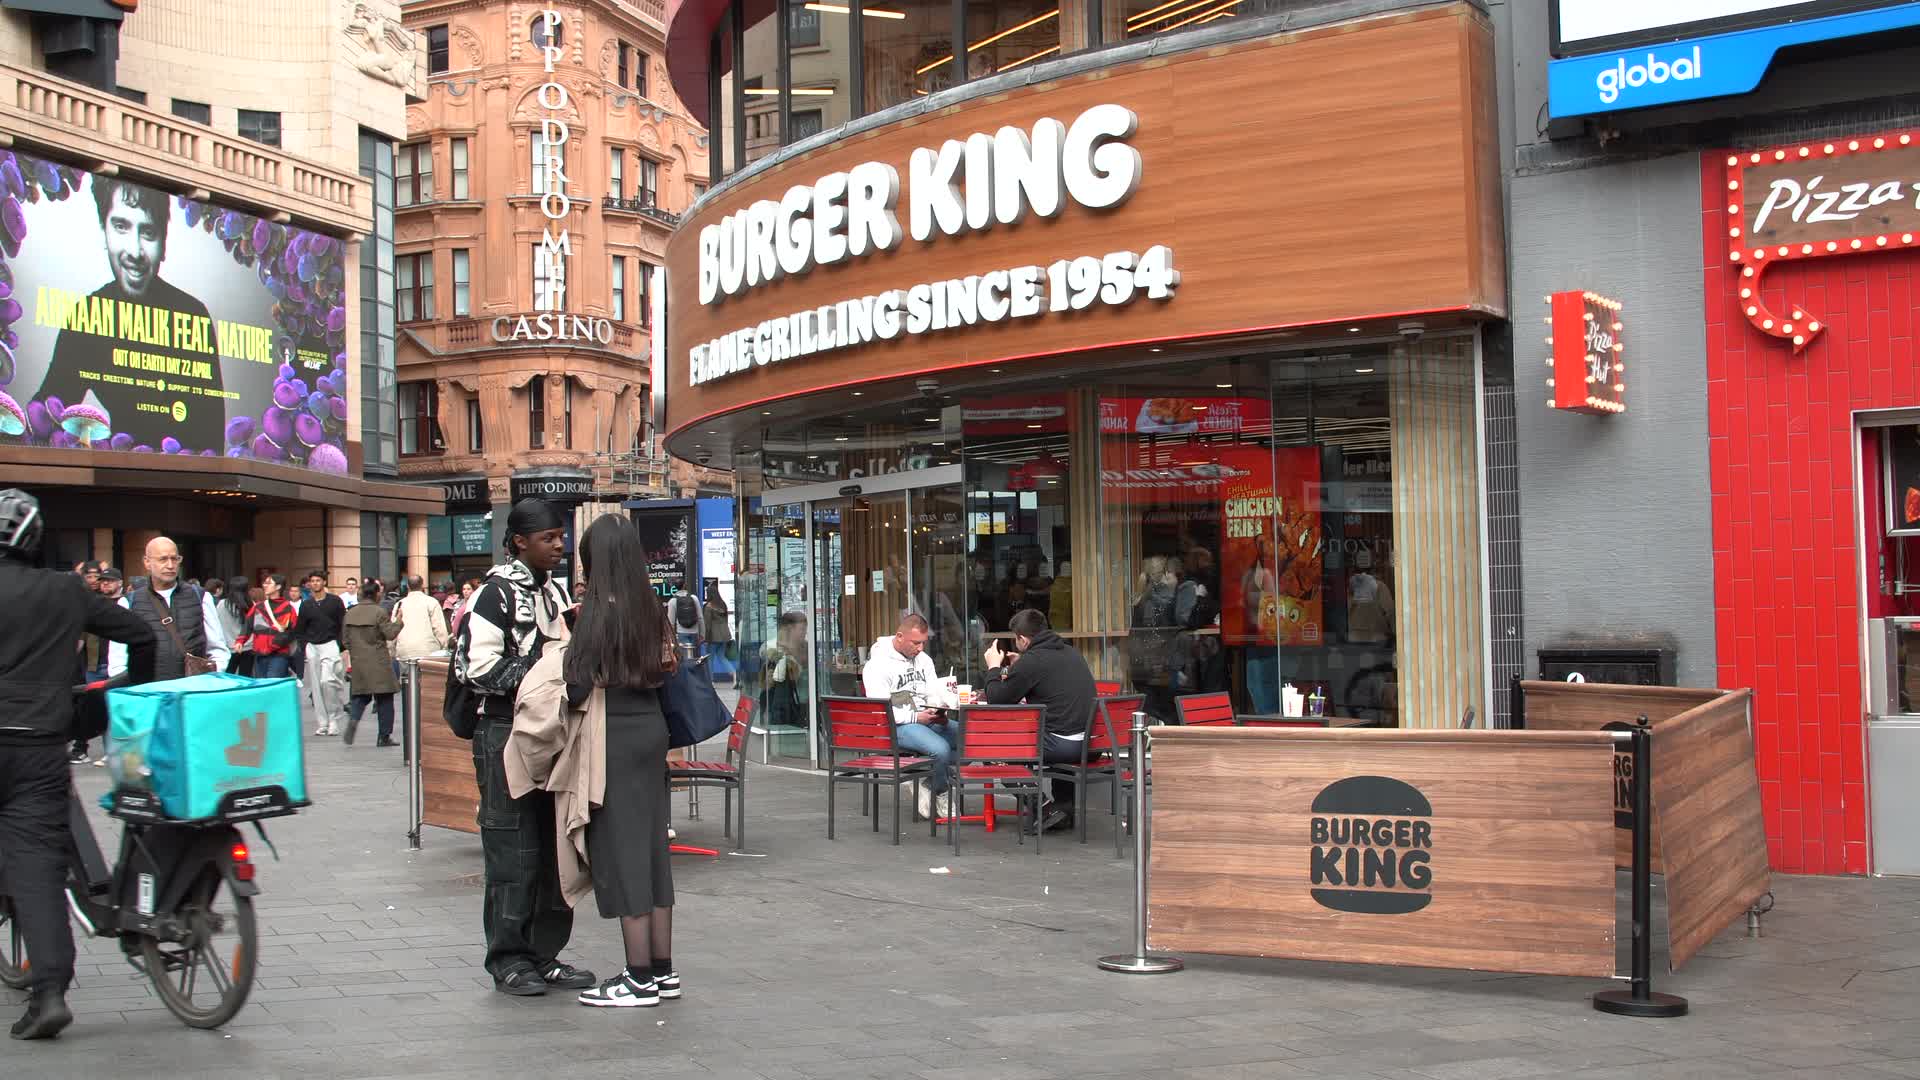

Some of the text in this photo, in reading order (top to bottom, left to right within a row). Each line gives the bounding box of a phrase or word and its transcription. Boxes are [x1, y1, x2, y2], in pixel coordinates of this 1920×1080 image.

[1595, 45, 1701, 103] global
[698, 103, 1142, 305] BURGER KING
[1752, 175, 1905, 233] Pizza
[34, 286, 273, 365] ARMAAN MALIK FEAT. NATURE
[490, 313, 614, 345] CASINO
[689, 244, 1181, 387] FLAME GRILLING SINCE 1954
[1586, 320, 1613, 354] Pizza
[112, 348, 213, 380] OUT ON EARTH DAY 22 APRIL
[1590, 353, 1612, 385] Hut
[79, 370, 101, 381] TRACKS
[135, 378, 157, 389] NATURE
[167, 383, 190, 393] SUPPORT
[136, 402, 170, 415] LISTEN ON
[519, 482, 592, 495] HIPPODROME
[1225, 496, 1283, 518] CHICKEN
[1226, 518, 1263, 538] FRIES
[650, 563, 669, 571] Calling
[1310, 817, 1432, 848] BURGER
[1310, 845, 1433, 889] KING
